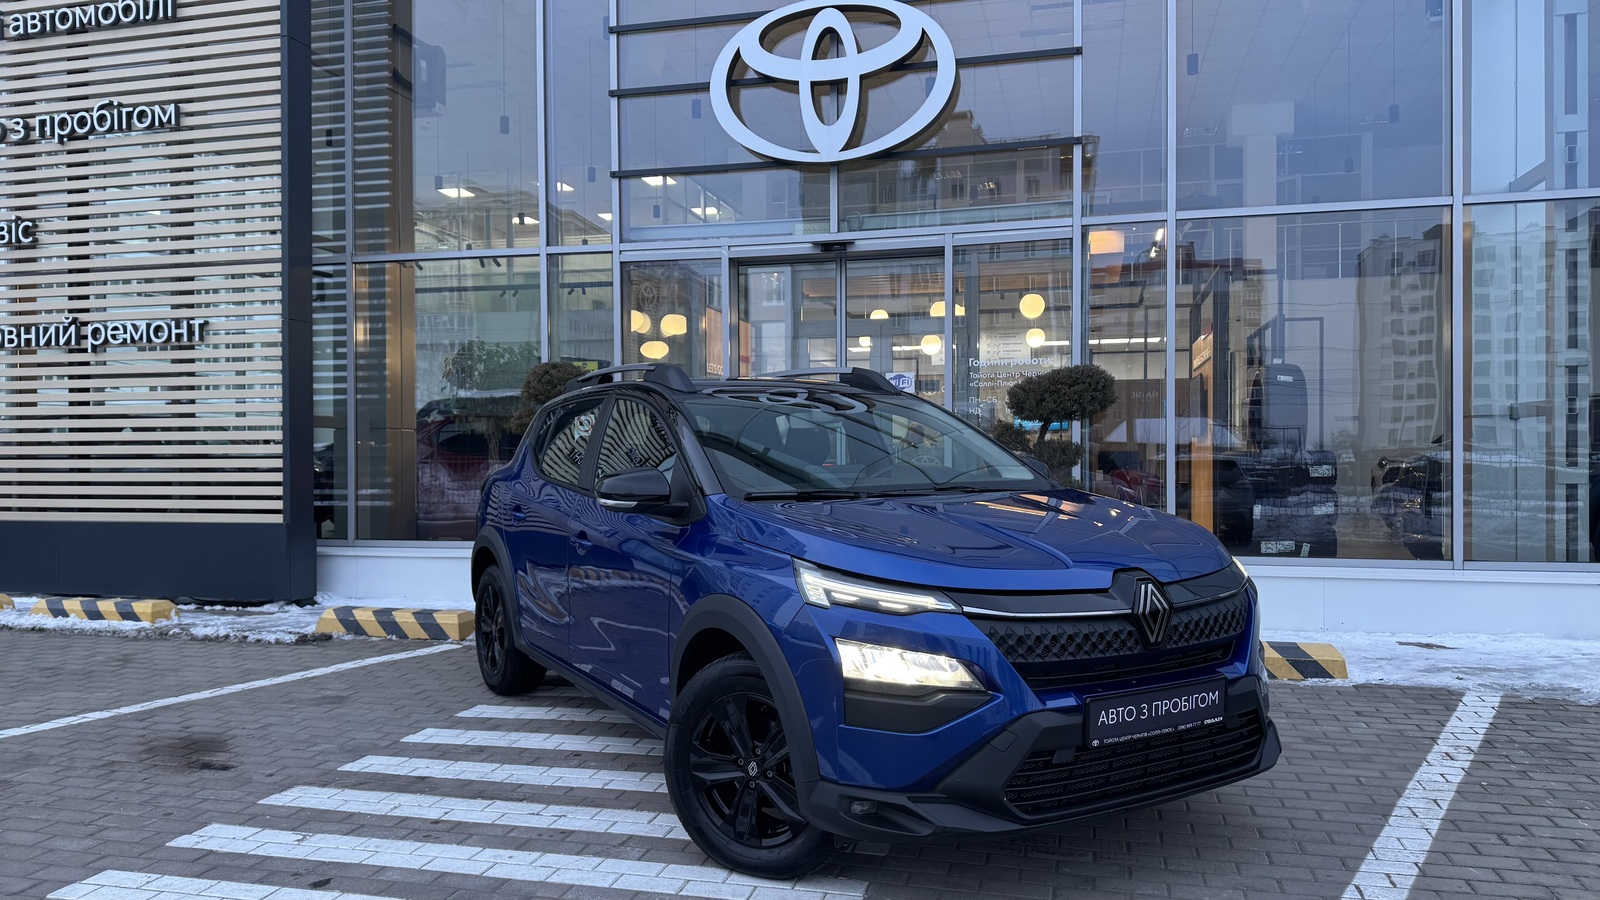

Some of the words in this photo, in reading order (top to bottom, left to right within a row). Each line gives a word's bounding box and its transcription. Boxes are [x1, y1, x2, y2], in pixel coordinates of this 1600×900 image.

[11, 117, 25, 140] з
[35, 100, 176, 144] пробігом
[0, 316, 76, 348] вний
[87, 319, 206, 354] ремонт
[968, 358, 1008, 368] Години
[969, 371, 995, 379] Тойота
[996, 371, 1020, 379] Центр
[1097, 705, 1137, 726] АВТО
[1140, 703, 1149, 719] З
[1152, 690, 1219, 717] ПРОБІГОМ
